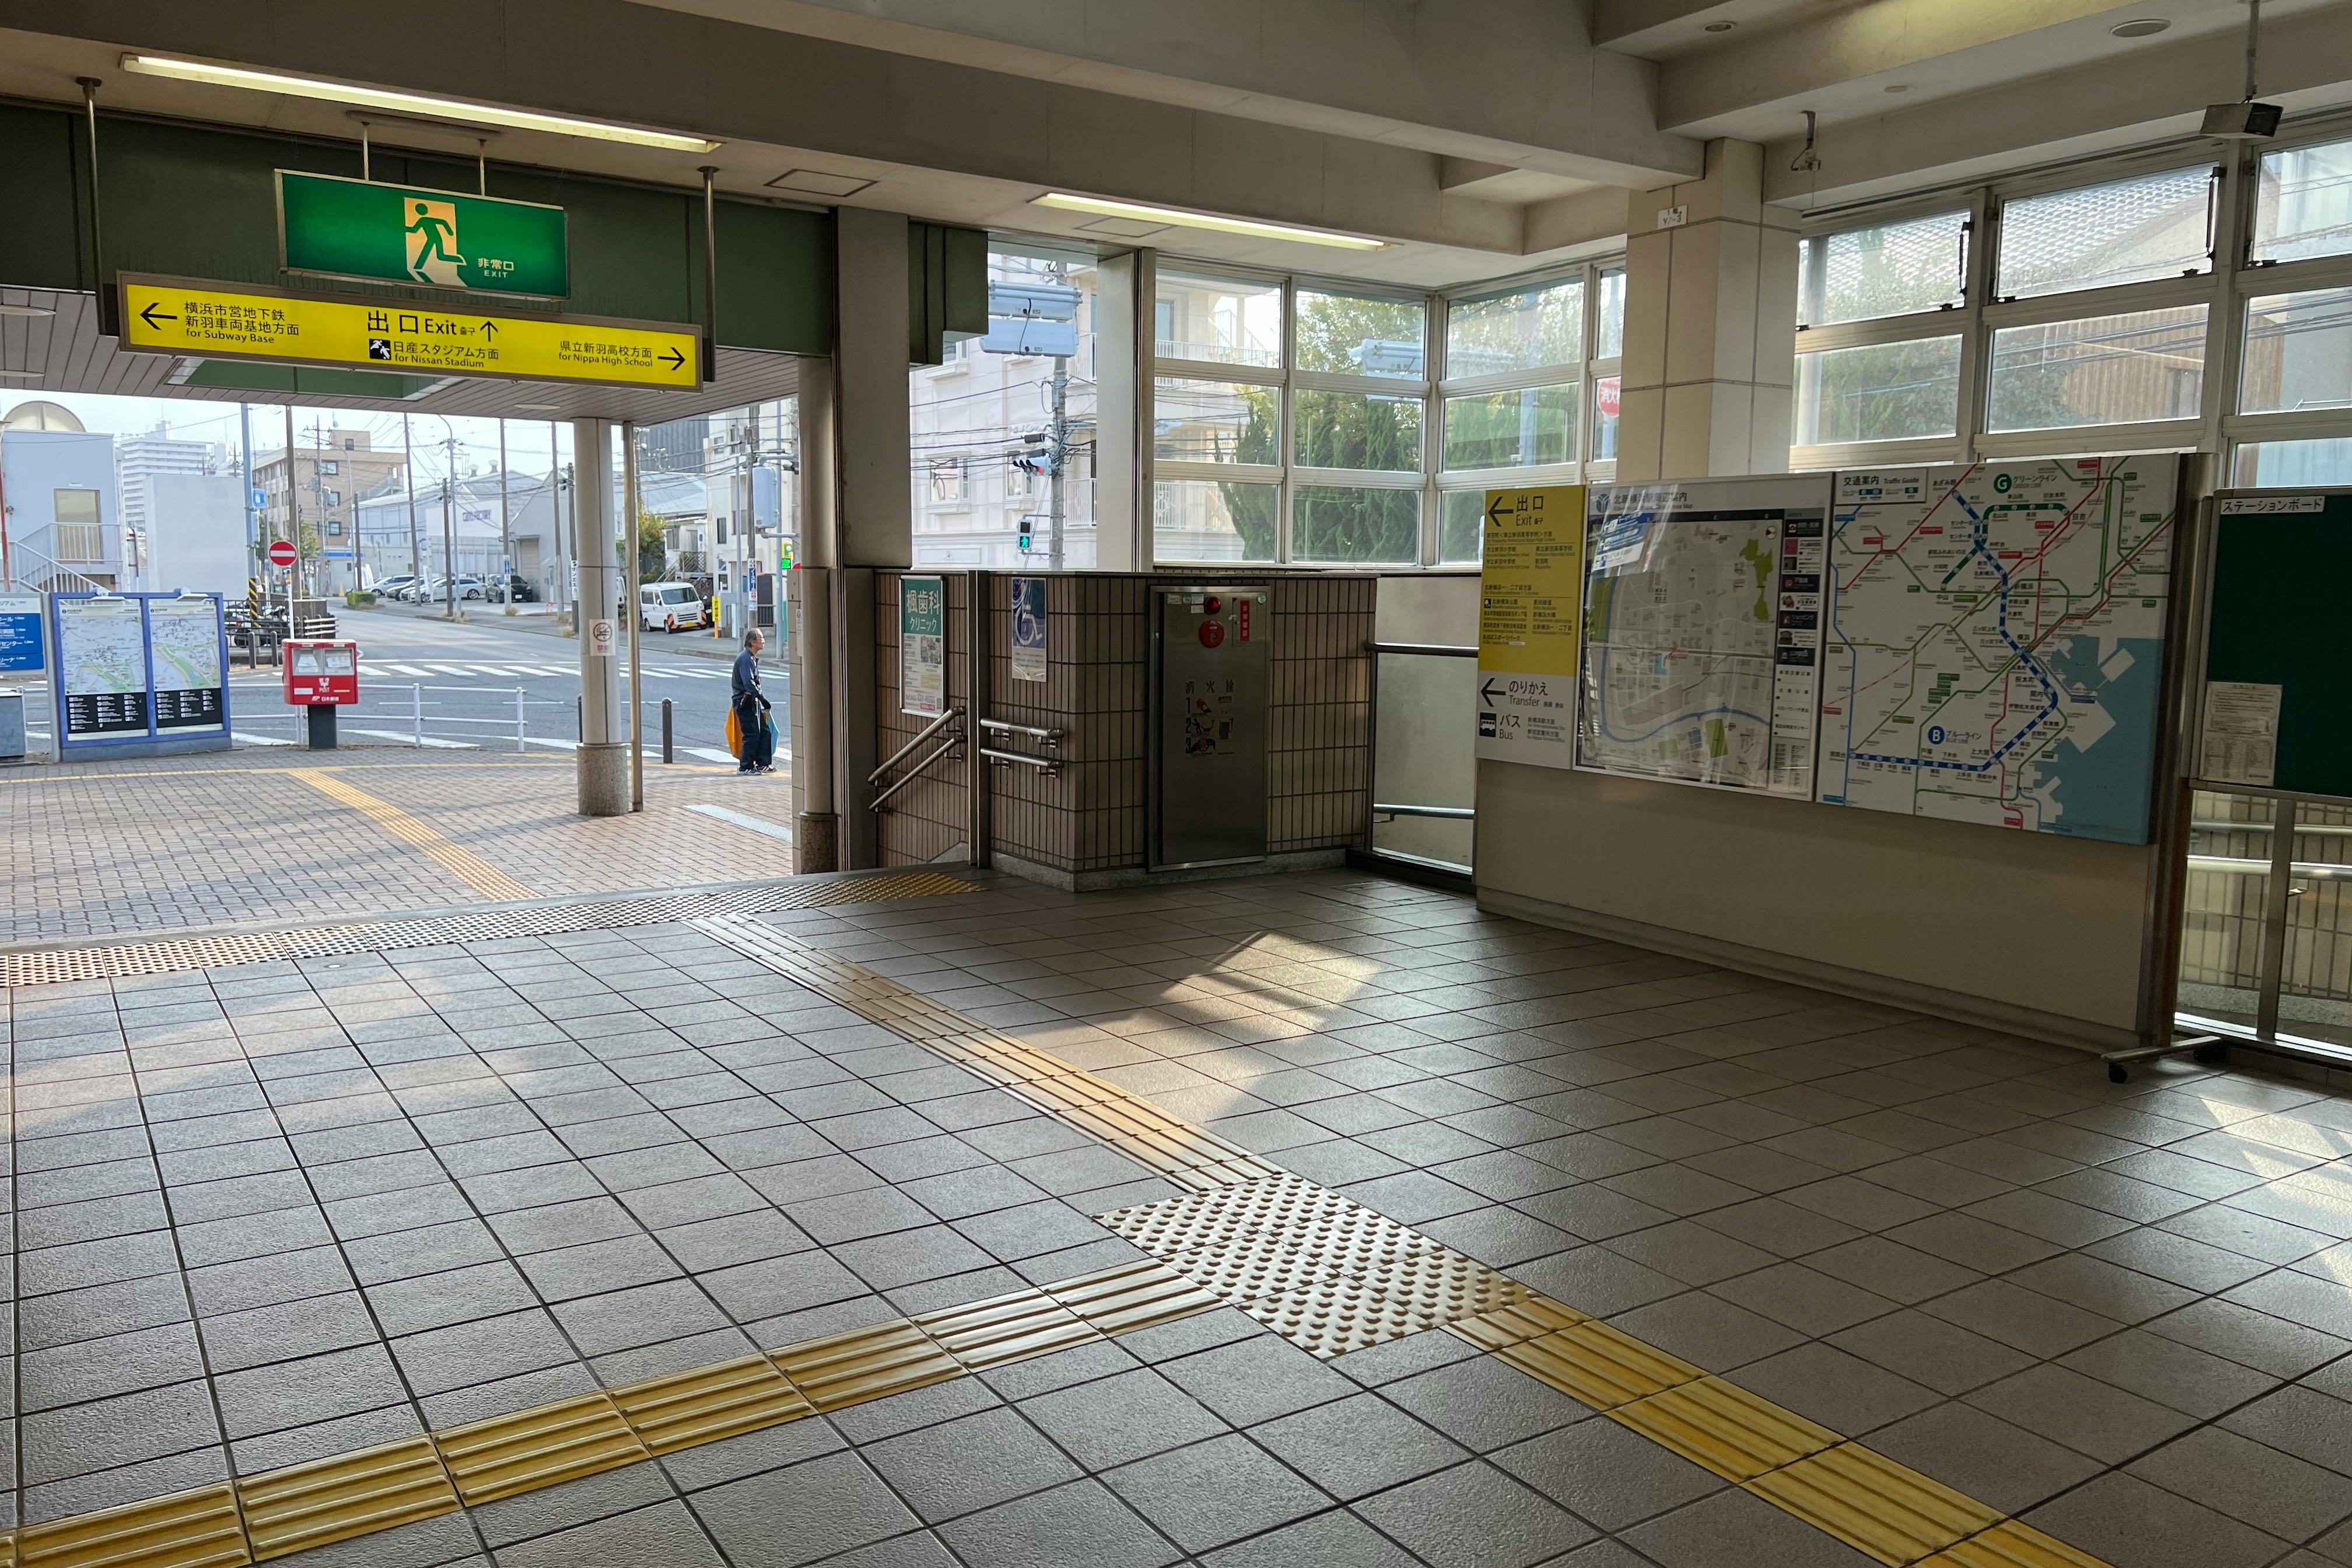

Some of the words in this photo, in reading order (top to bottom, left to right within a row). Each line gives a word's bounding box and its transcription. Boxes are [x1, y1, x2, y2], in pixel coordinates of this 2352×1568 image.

[477, 257, 514, 271] 非常口
[484, 270, 508, 278] EXIT
[184, 301, 285, 321] 横浜市営地下鉄
[185, 315, 299, 336] 新羽車両基地方面
[368, 310, 419, 334] 出口
[425, 318, 457, 335] Exit
[186, 328, 201, 337] for
[205, 330, 247, 343] Subway
[250, 333, 274, 343] Base
[394, 341, 499, 360] 日産スタジアム方面
[560, 340, 652, 358] 県立新羽高校方面
[395, 353, 408, 362] for
[411, 355, 442, 365] Nissan
[445, 357, 484, 368] Stadium
[559, 352, 570, 360] for
[573, 354, 599, 364] Nippa
[602, 355, 622, 366] High
[625, 358, 652, 367] School
[1601, 387, 1620, 404] 消火
[1843, 475, 1880, 487] 交通案内
[1997, 477, 2008, 490] G
[2013, 475, 2057, 484] グリーンライン
[1517, 495, 1544, 512] 出口
[2223, 498, 2323, 512] ステーションボード
[1516, 514, 1532, 526] Exit
[906, 589, 940, 615] 楓歯科
[909, 617, 937, 632] クリニック
[1508, 680, 1548, 696] のりかえ
[1509, 695, 1539, 707] Transfer
[1500, 714, 1521, 728] バス
[1499, 729, 1513, 740] Bus
[1932, 730, 1940, 741] B
[1945, 730, 1982, 740] ブルーライン
